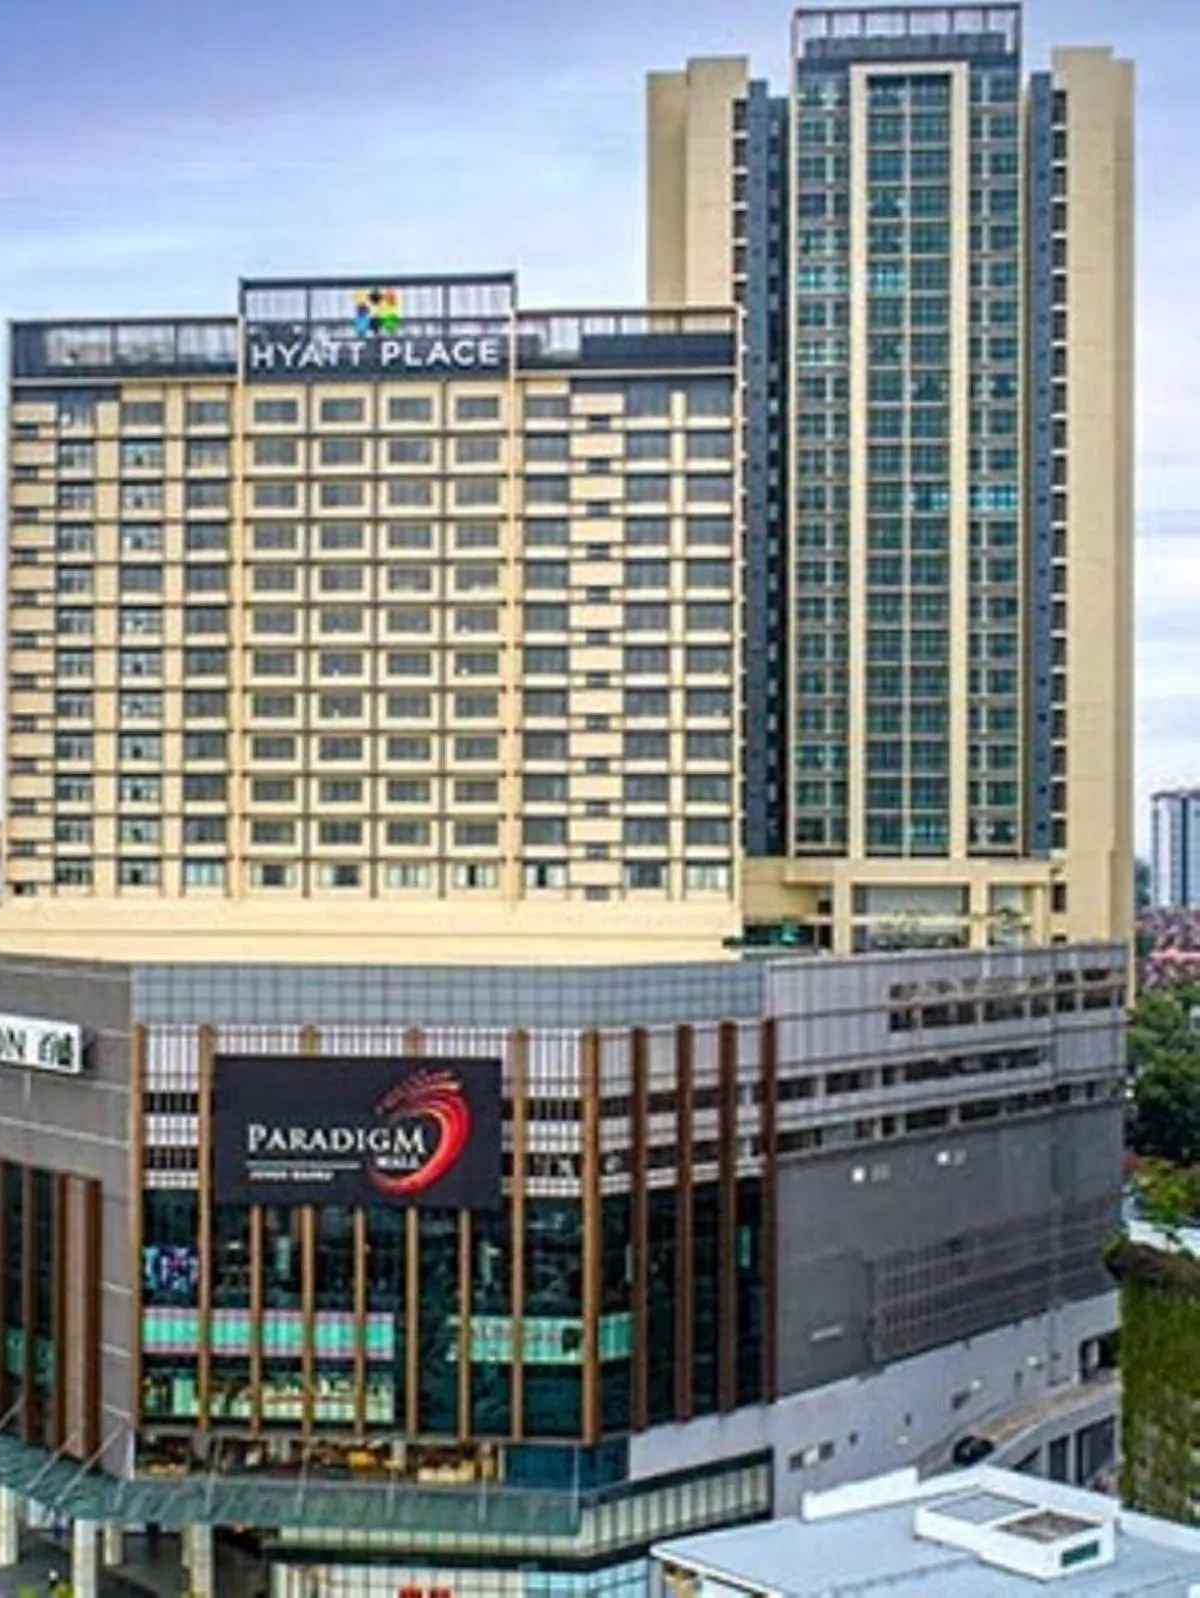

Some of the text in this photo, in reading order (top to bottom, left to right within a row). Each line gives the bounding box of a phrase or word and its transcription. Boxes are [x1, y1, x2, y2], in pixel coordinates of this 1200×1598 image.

[252, 339, 499, 368] HYATT PLACE
[248, 1123, 425, 1153] PARADIGM
